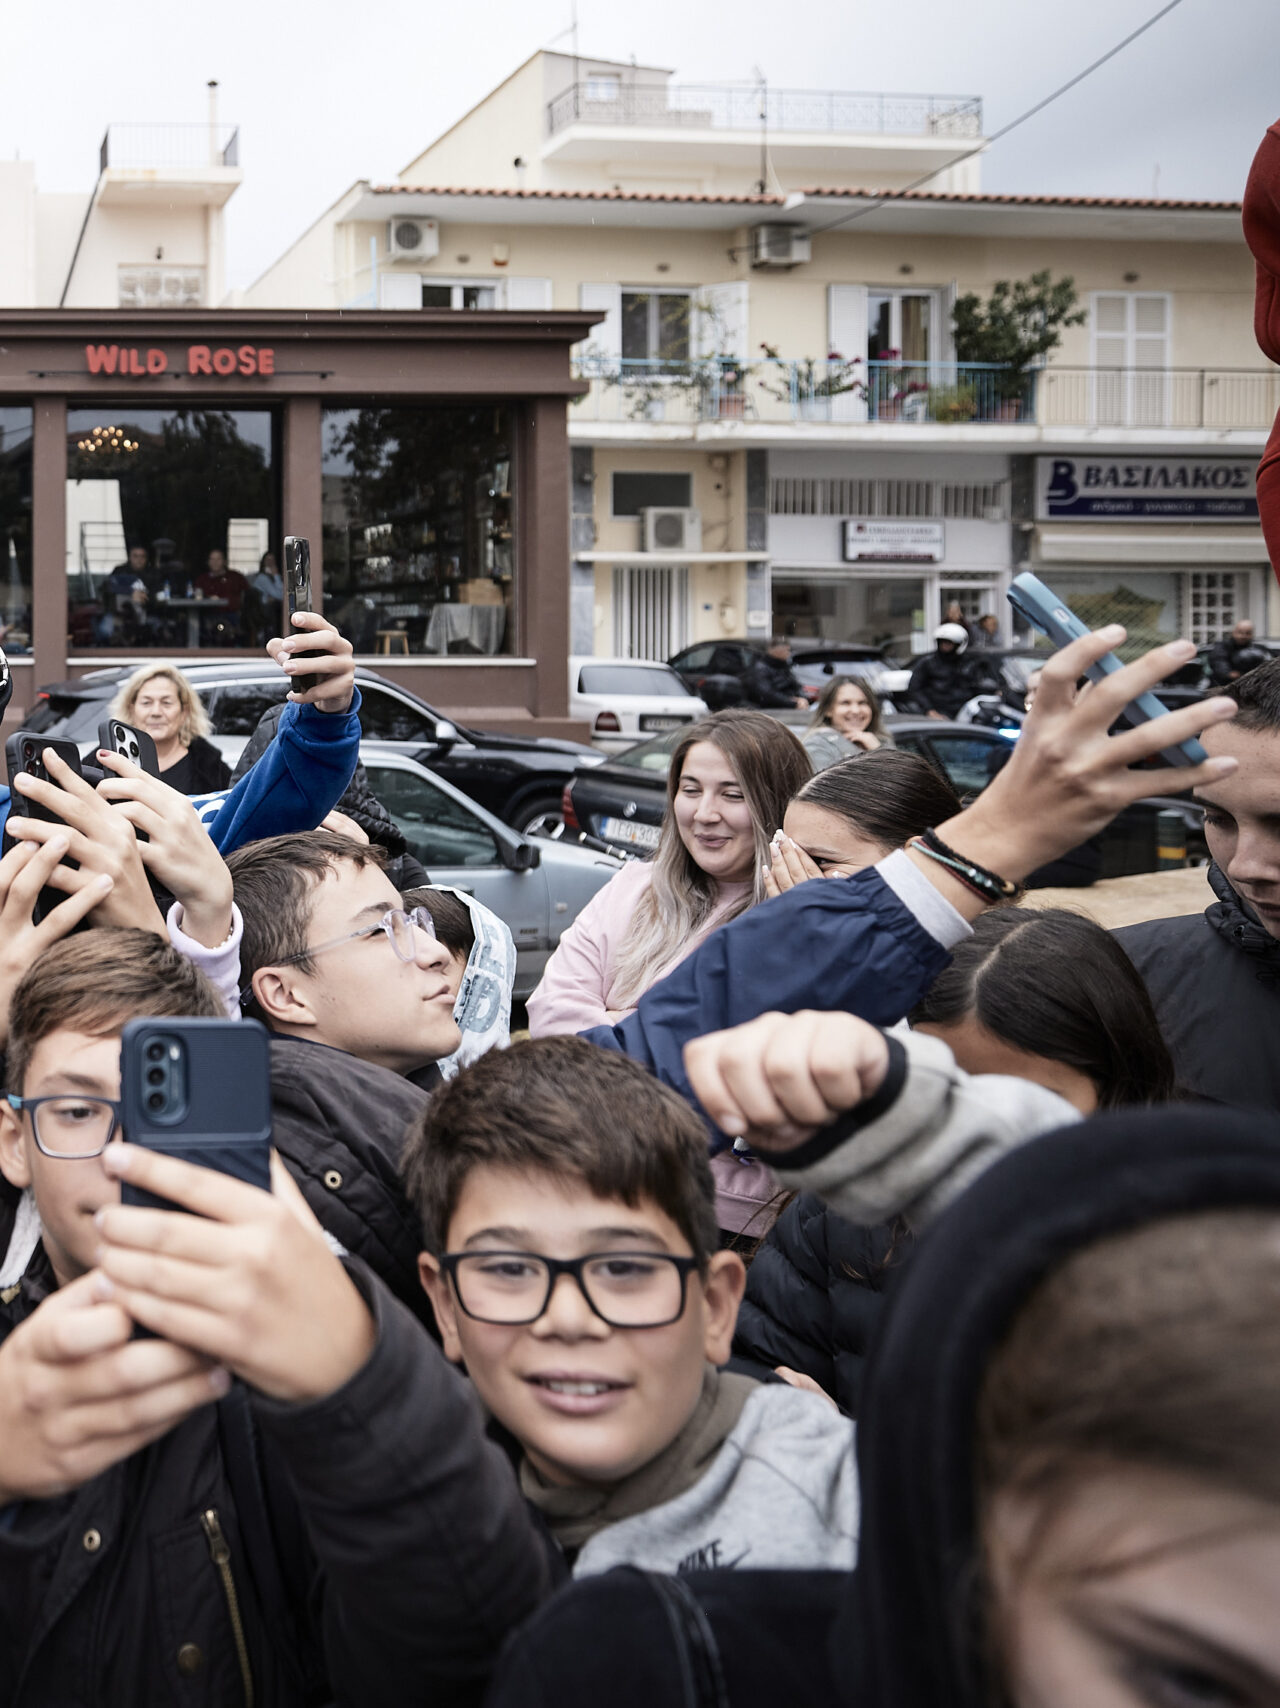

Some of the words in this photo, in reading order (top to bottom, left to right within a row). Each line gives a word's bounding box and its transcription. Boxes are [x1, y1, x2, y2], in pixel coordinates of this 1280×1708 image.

[86, 344, 169, 374] WILD
[187, 345, 275, 374] ROSE
[1082, 465, 1250, 489] ΒΑΣΙΛΑΚΟΣ
